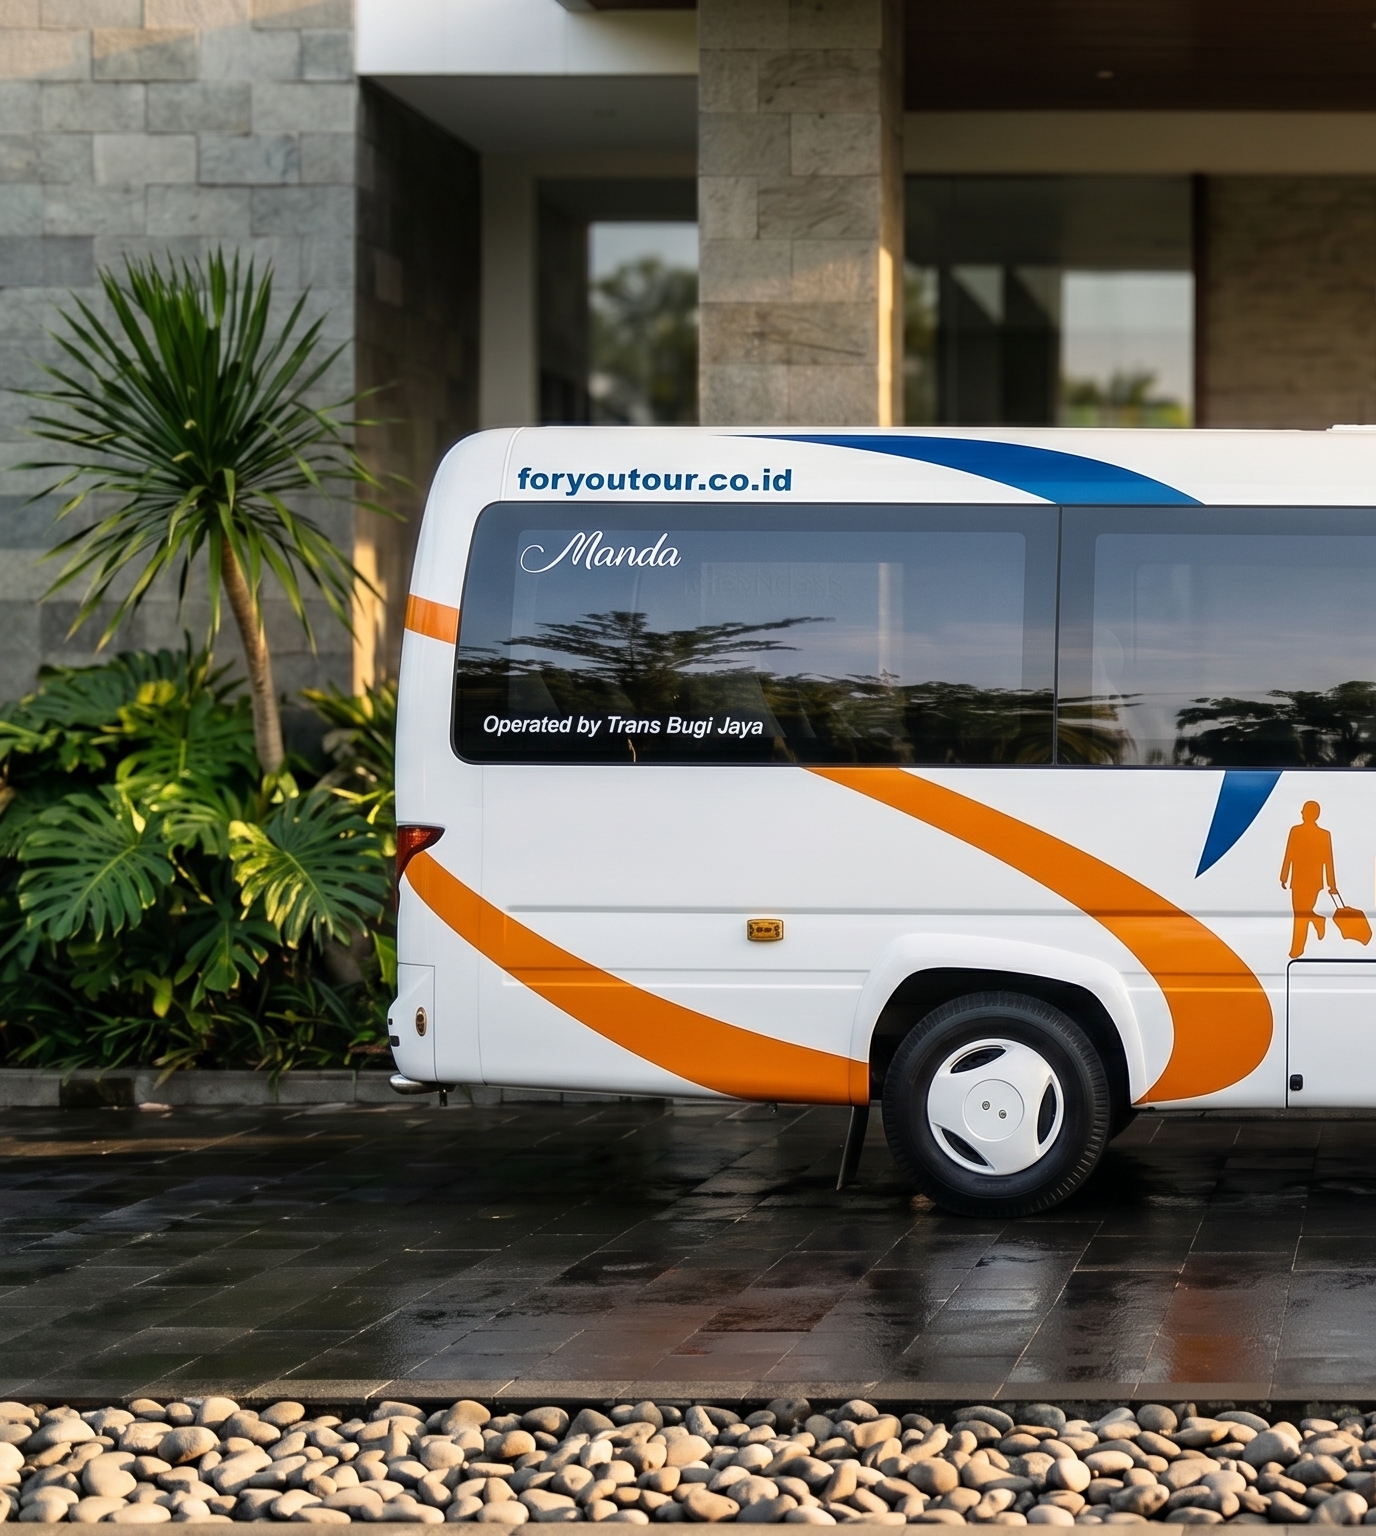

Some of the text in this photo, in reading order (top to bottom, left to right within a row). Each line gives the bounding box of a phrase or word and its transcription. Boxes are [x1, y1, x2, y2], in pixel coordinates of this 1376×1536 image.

[517, 467, 792, 497] foryoutour.co.id
[520, 530, 682, 574] Manda
[483, 715, 764, 739] Operated by Trans Bugi Jaya
